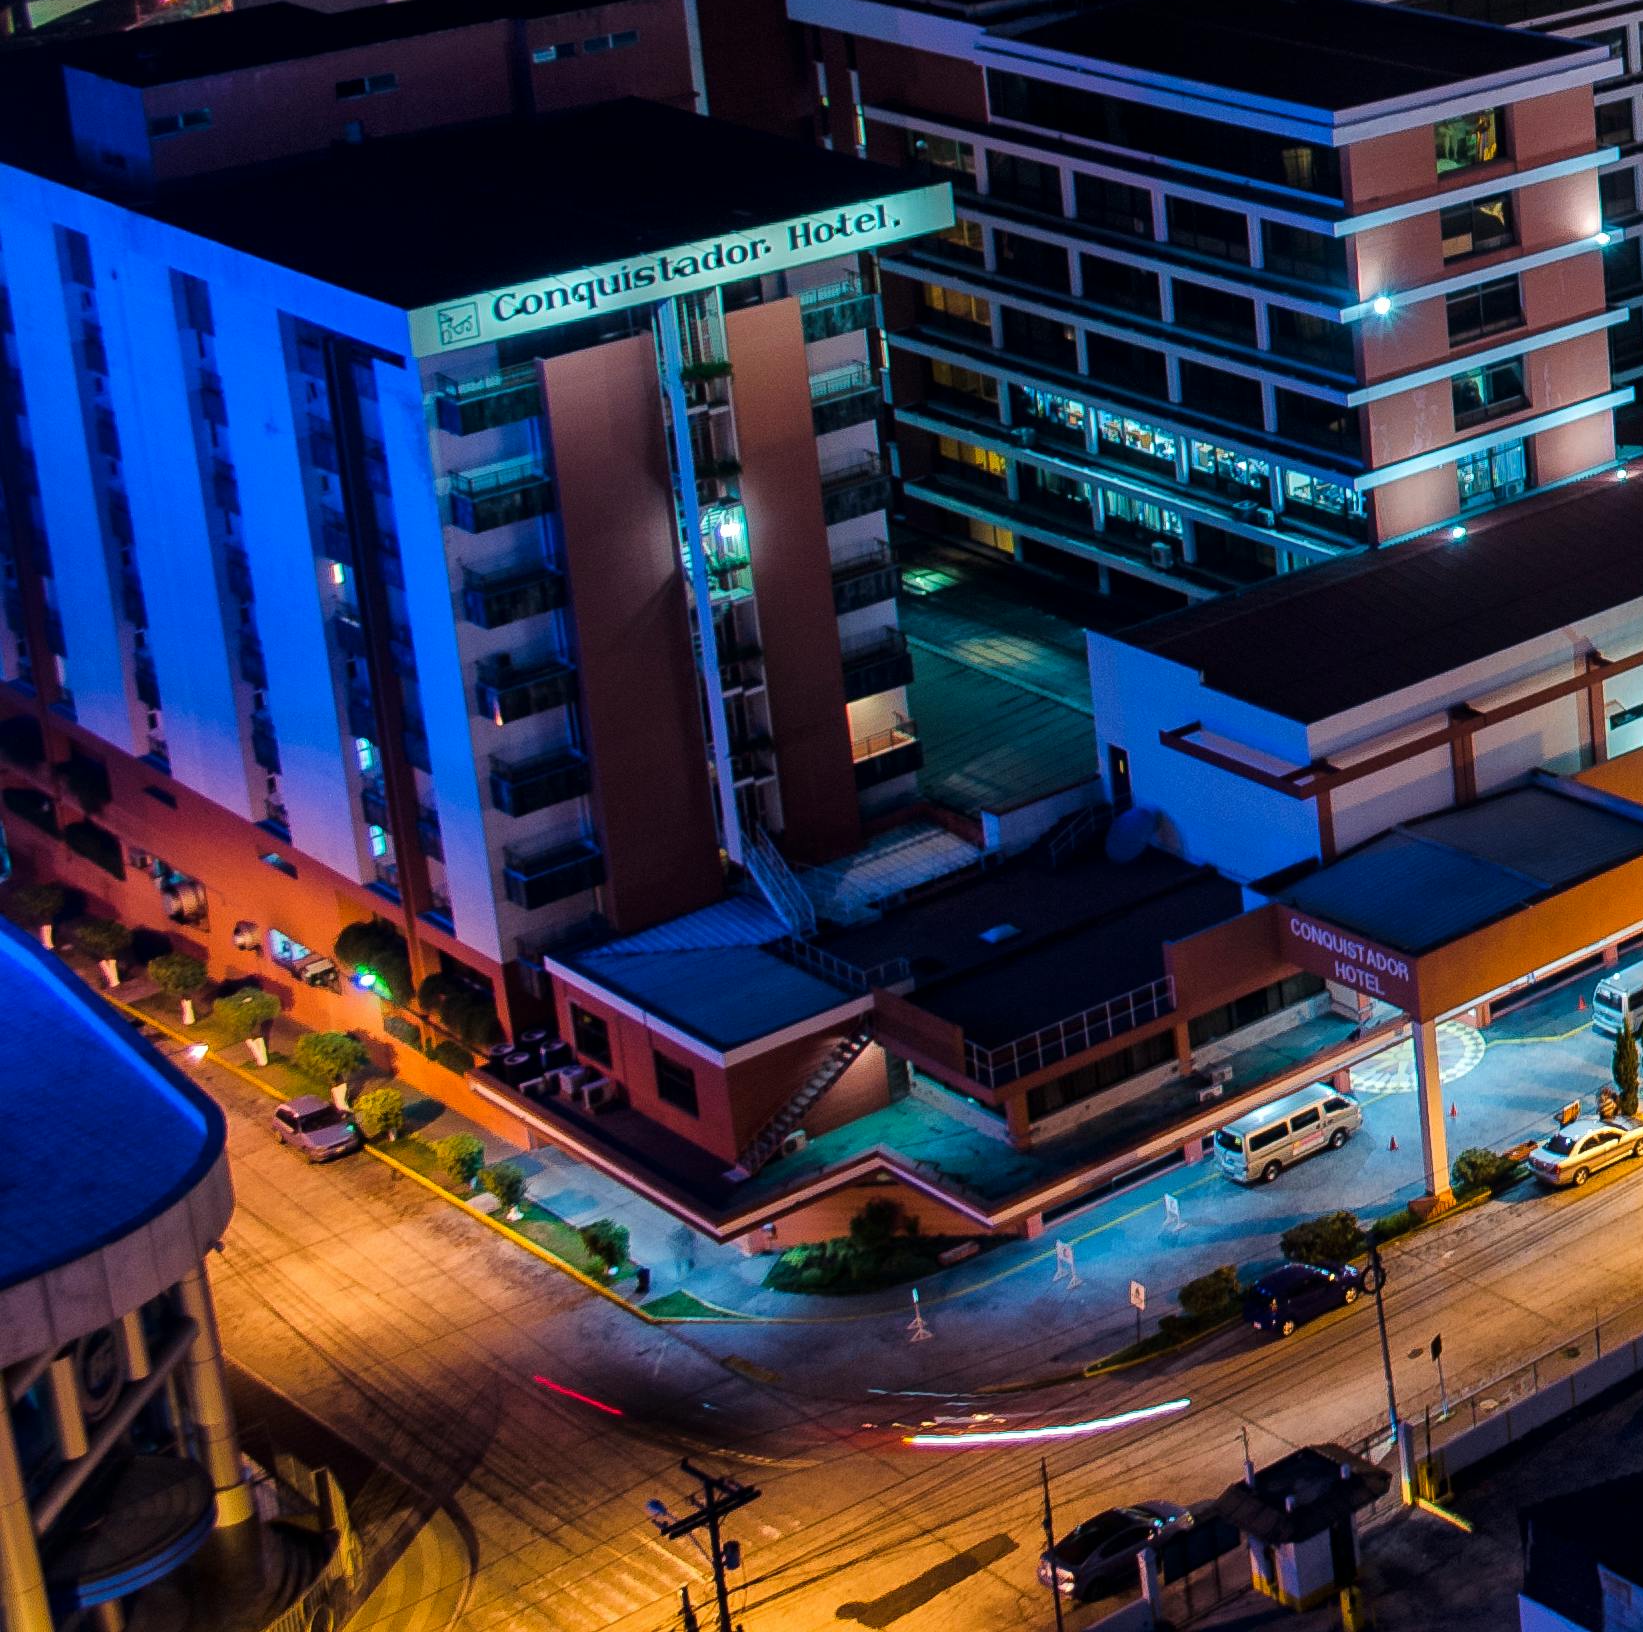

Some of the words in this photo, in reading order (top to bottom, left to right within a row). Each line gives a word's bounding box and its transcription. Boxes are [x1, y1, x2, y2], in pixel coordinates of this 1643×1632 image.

[492, 241, 764, 323] Conquistador
[788, 205, 888, 252] Hotel
[1290, 917, 1409, 982] CONQUISTADOR
[1334, 960, 1386, 996] HOTEL
